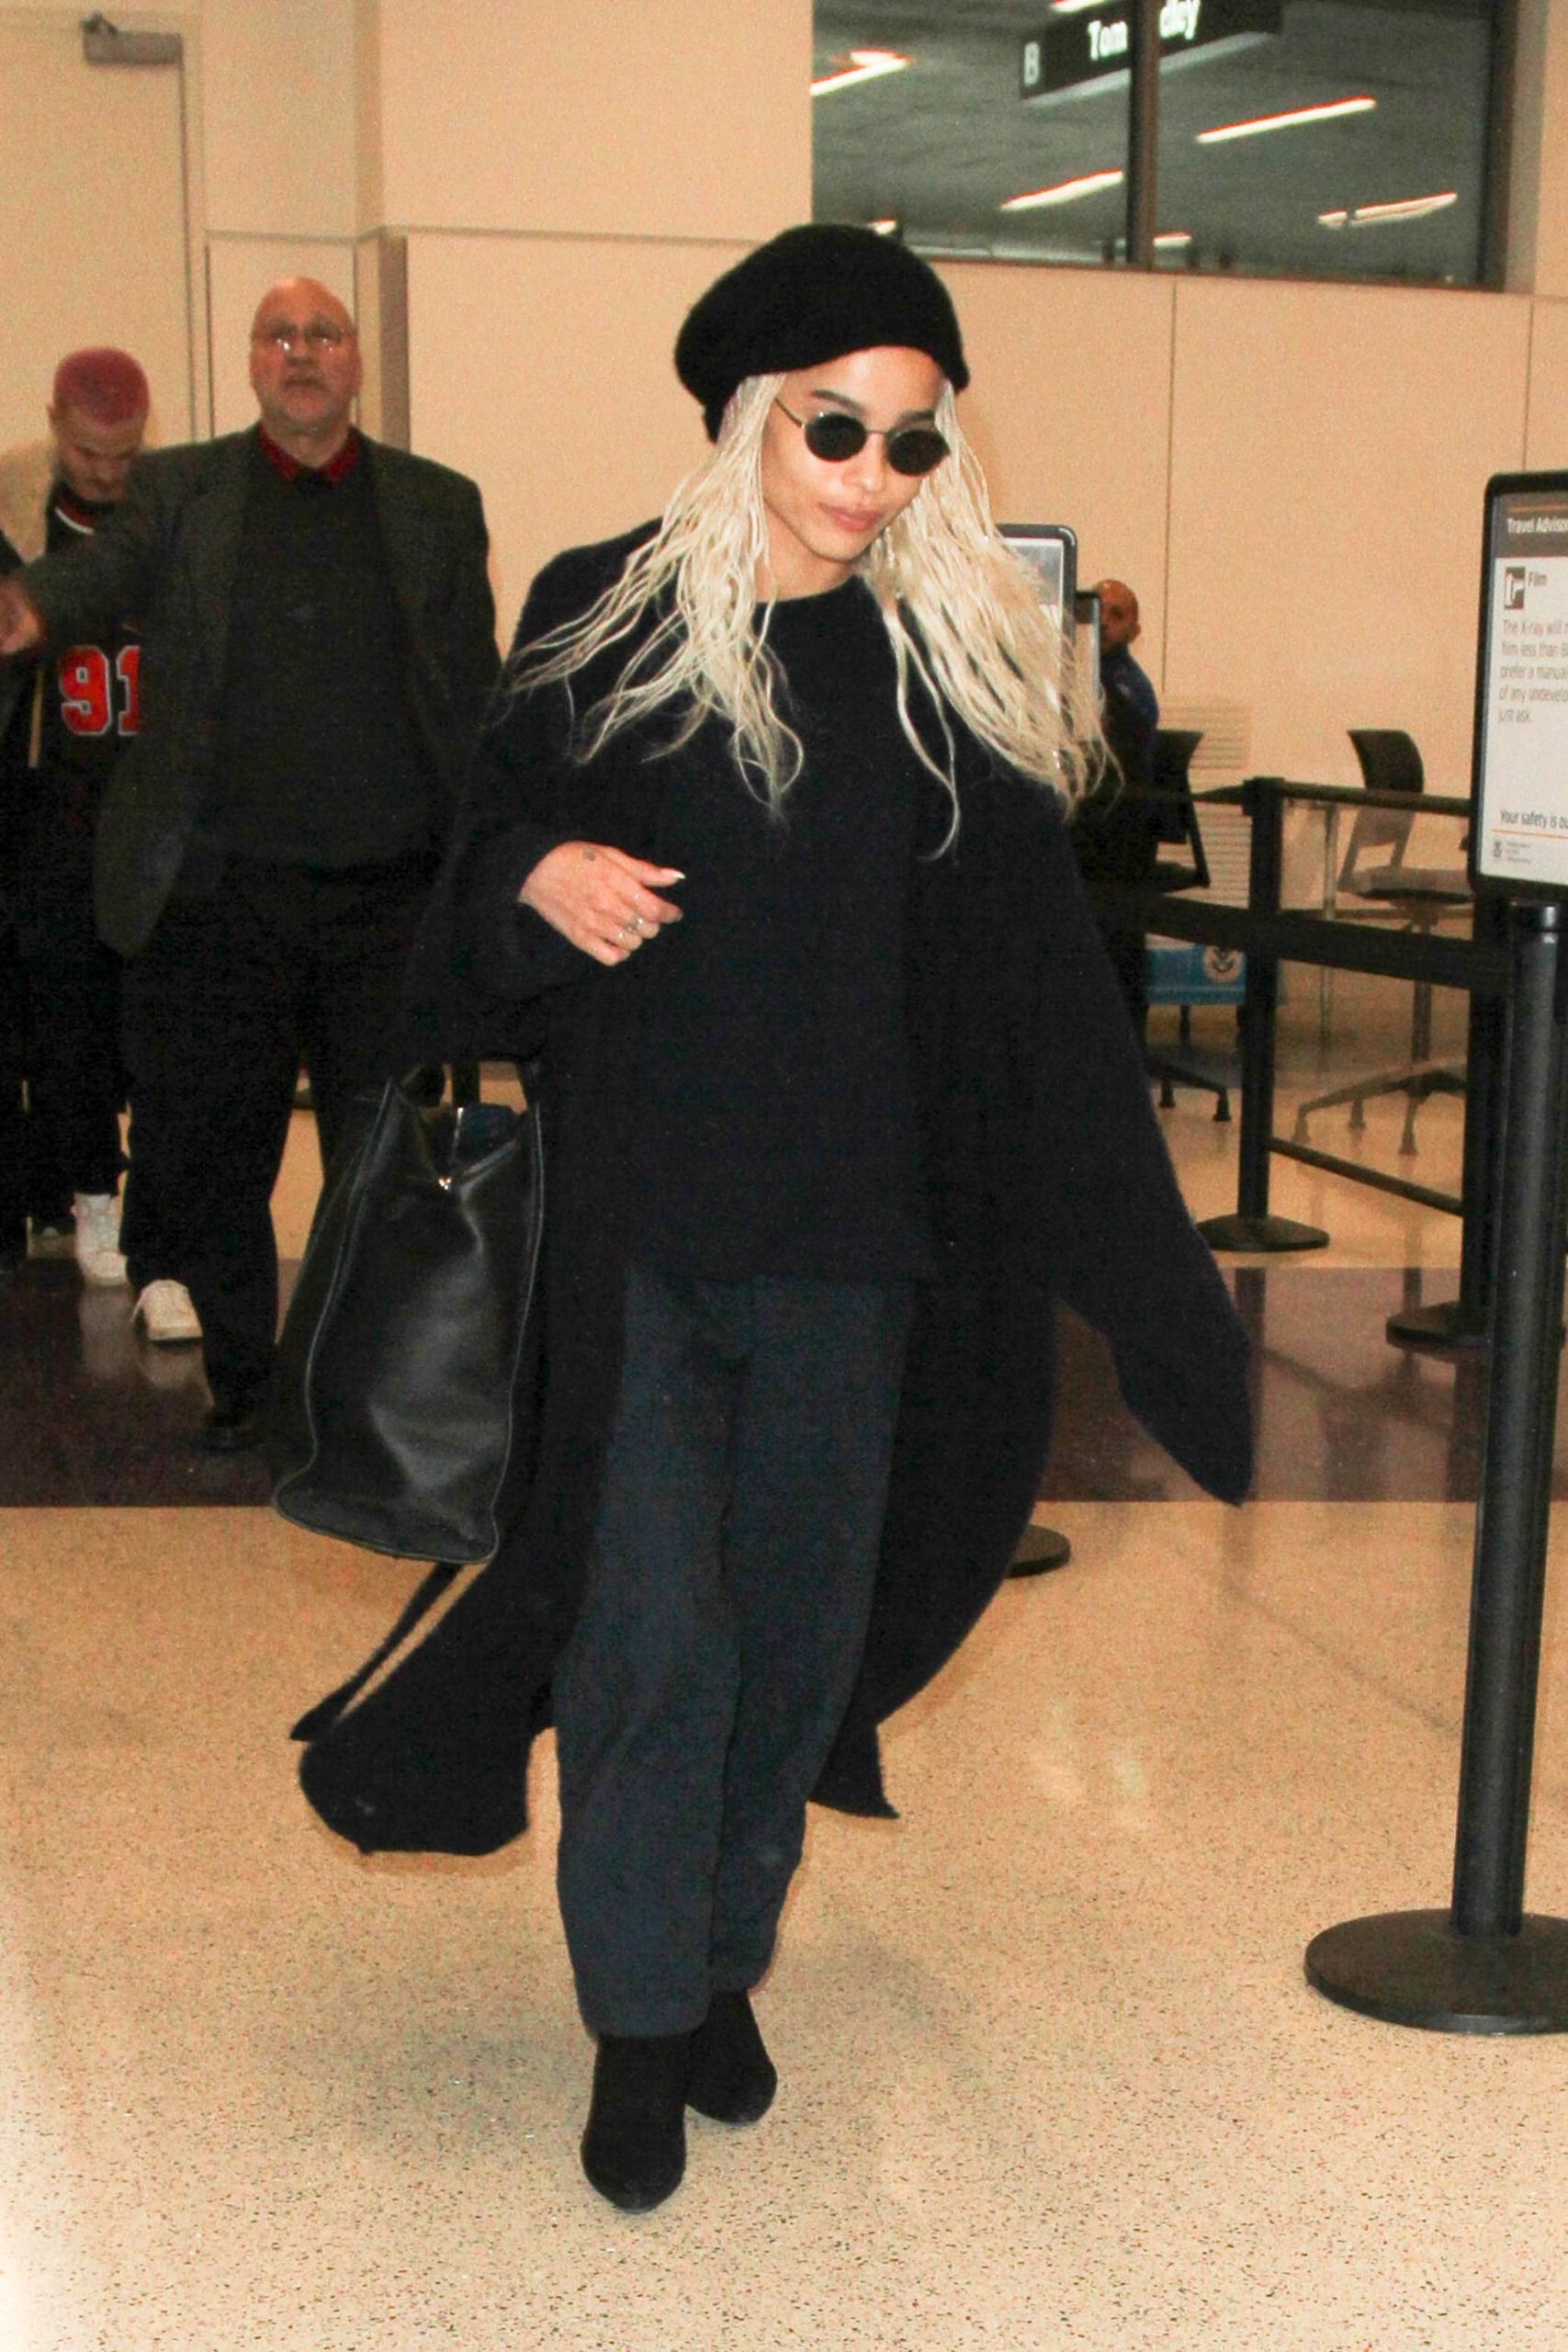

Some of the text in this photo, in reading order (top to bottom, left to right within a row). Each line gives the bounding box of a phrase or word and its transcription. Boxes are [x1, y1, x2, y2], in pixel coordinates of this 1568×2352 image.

[1088, 19, 1128, 61] Tom
[1506, 516, 1535, 534] Travel
[1528, 571, 1548, 587] Film
[1503, 619, 1518, 634] The
[1521, 642, 1537, 657] less
[1539, 642, 1560, 658] than
[58, 645, 140, 736] 91
[1498, 684, 1508, 701] of
[1510, 688, 1526, 704] any
[1500, 808, 1519, 825] Your
[1521, 811, 1548, 830] safety
